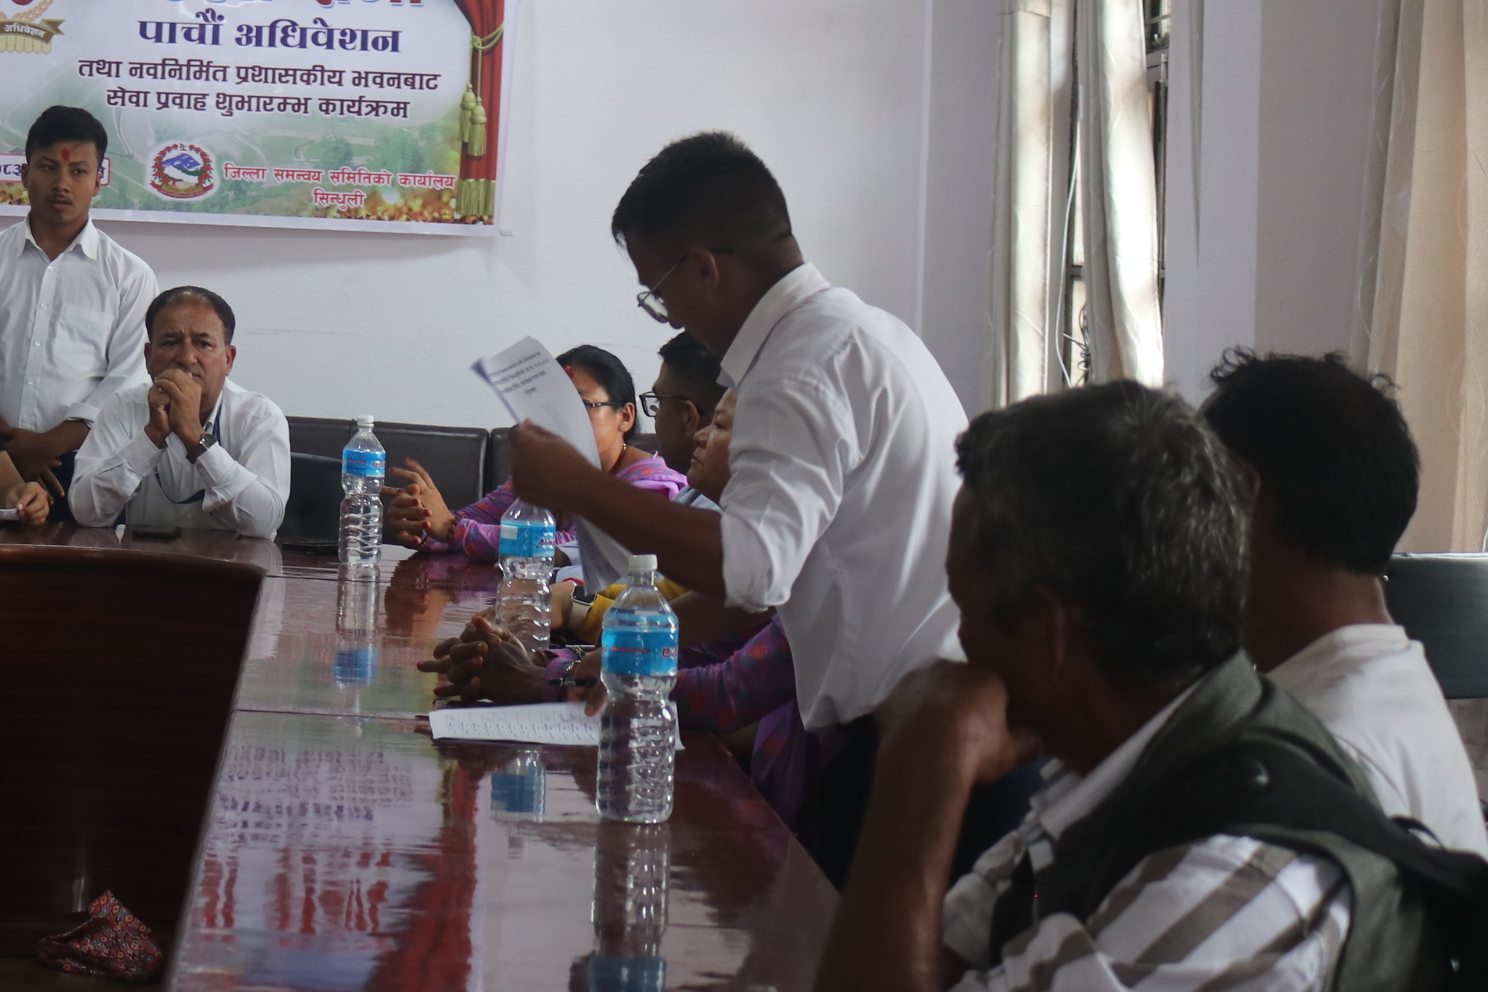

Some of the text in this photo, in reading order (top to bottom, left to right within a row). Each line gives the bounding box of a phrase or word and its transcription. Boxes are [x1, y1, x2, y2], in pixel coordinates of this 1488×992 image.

[4, 23, 46, 39] अधिवेशन
[137, 7, 403, 53] पाचौं अधिवेशन
[78, 58, 442, 91] तथा नवनिर्मित प्रशासकीय भवनबाट
[106, 86, 411, 119] सेवा प्रवाह शुभारम्भ कार्यक्रम
[223, 161, 457, 190] जिल्ला समन्वय समितिको कार्यालय
[313, 188, 366, 212] सिन्धुली
